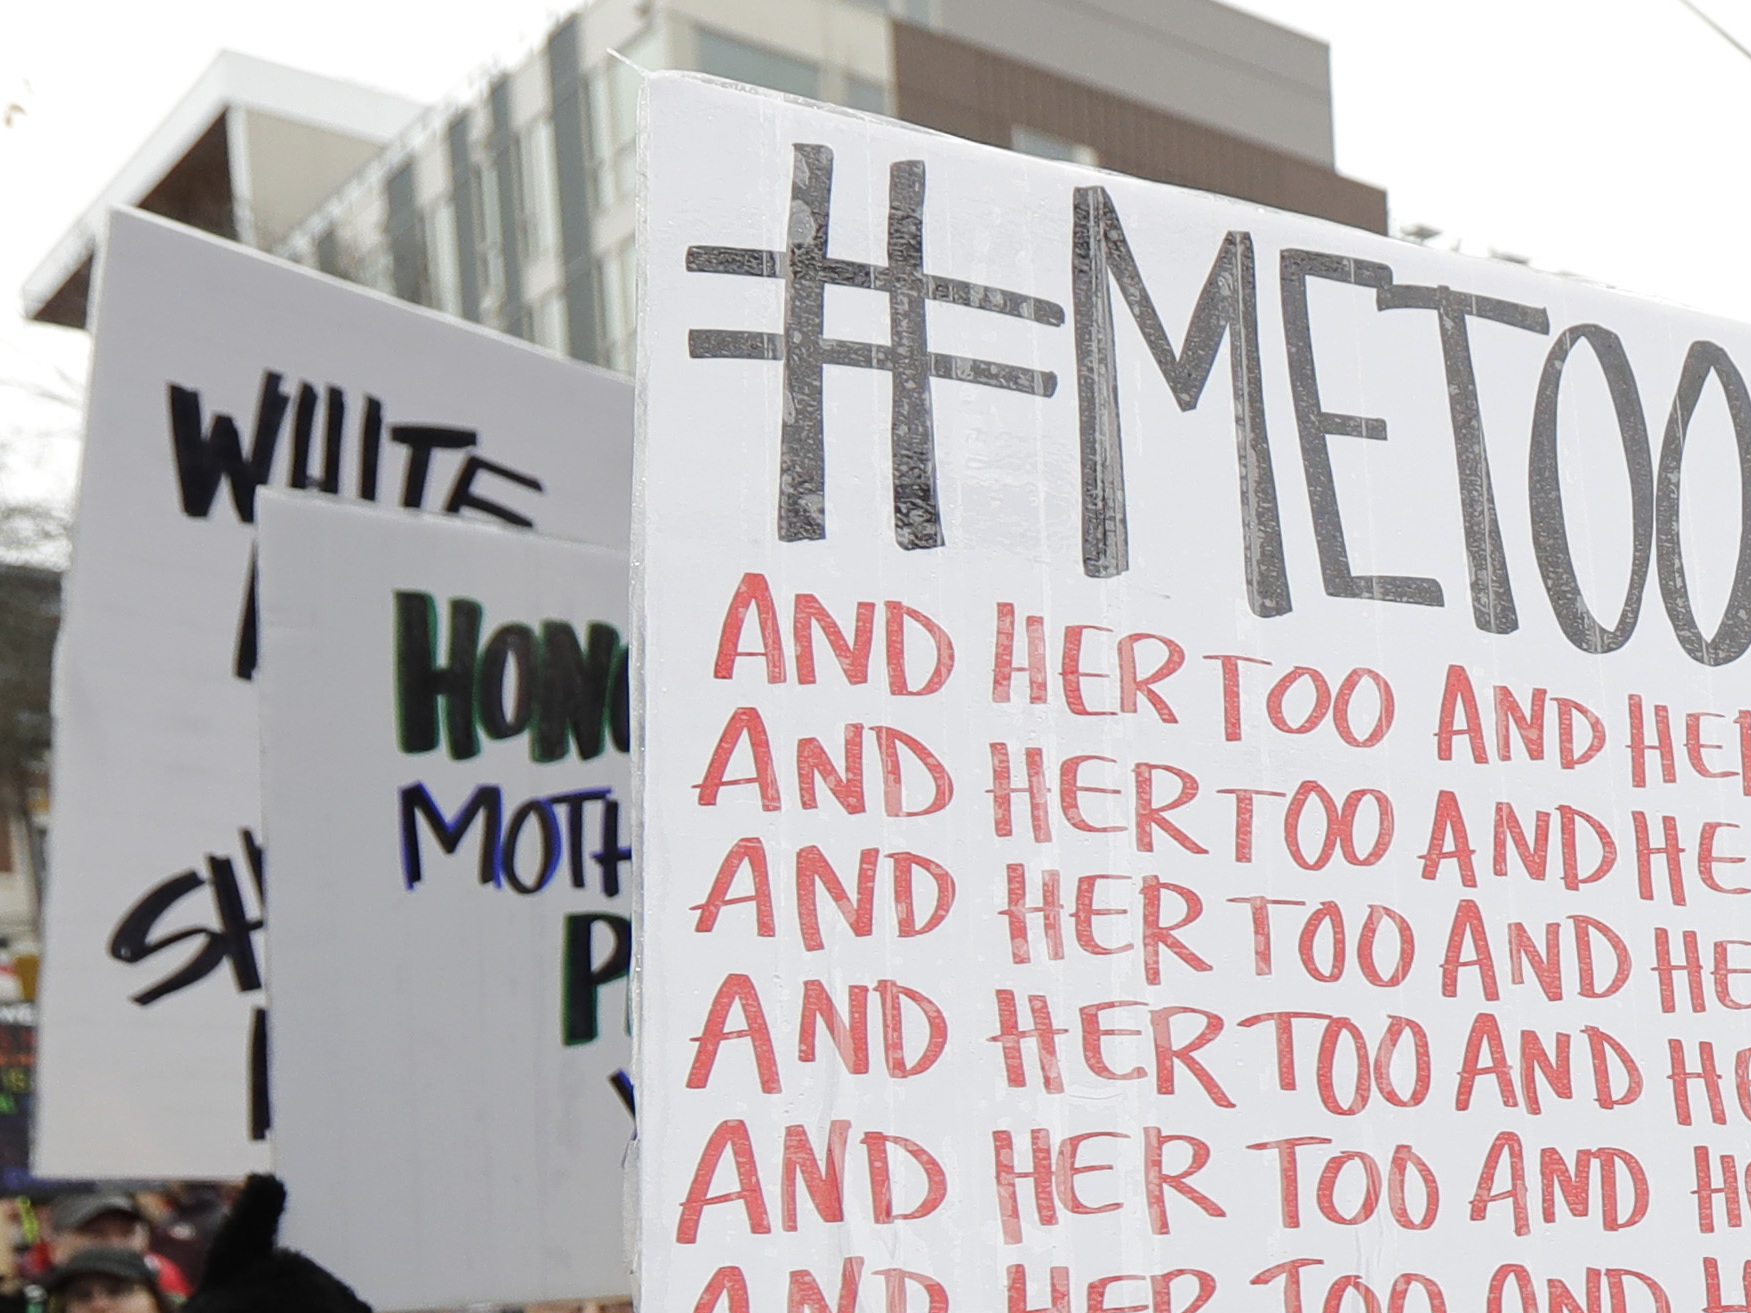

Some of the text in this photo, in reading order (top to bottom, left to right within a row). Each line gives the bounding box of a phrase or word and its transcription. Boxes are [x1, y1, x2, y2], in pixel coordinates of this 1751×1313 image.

[391, 589, 631, 762] HON
[714, 573, 955, 696] AND
[993, 602, 1185, 723] HER
[1203, 655, 1395, 748] TOO
[1434, 664, 1605, 770] AND
[691, 707, 954, 817] AND
[986, 742, 1209, 852] HER
[1216, 780, 1394, 870] TOO
[1418, 790, 1617, 892] AND
[689, 837, 956, 951] AND
[999, 863, 1214, 985] HER
[1227, 896, 1414, 987] TOO
[1439, 899, 1632, 1002] AND
[686, 973, 948, 1093] AND
[987, 989, 1236, 1108] HER
[1237, 1012, 1431, 1115] TOO
[1455, 1012, 1644, 1115] AND
[675, 1119, 947, 1245] AND
[993, 1126, 1226, 1245] HER
[1246, 1137, 1439, 1230] TOO
[1469, 1131, 1649, 1237] AND
